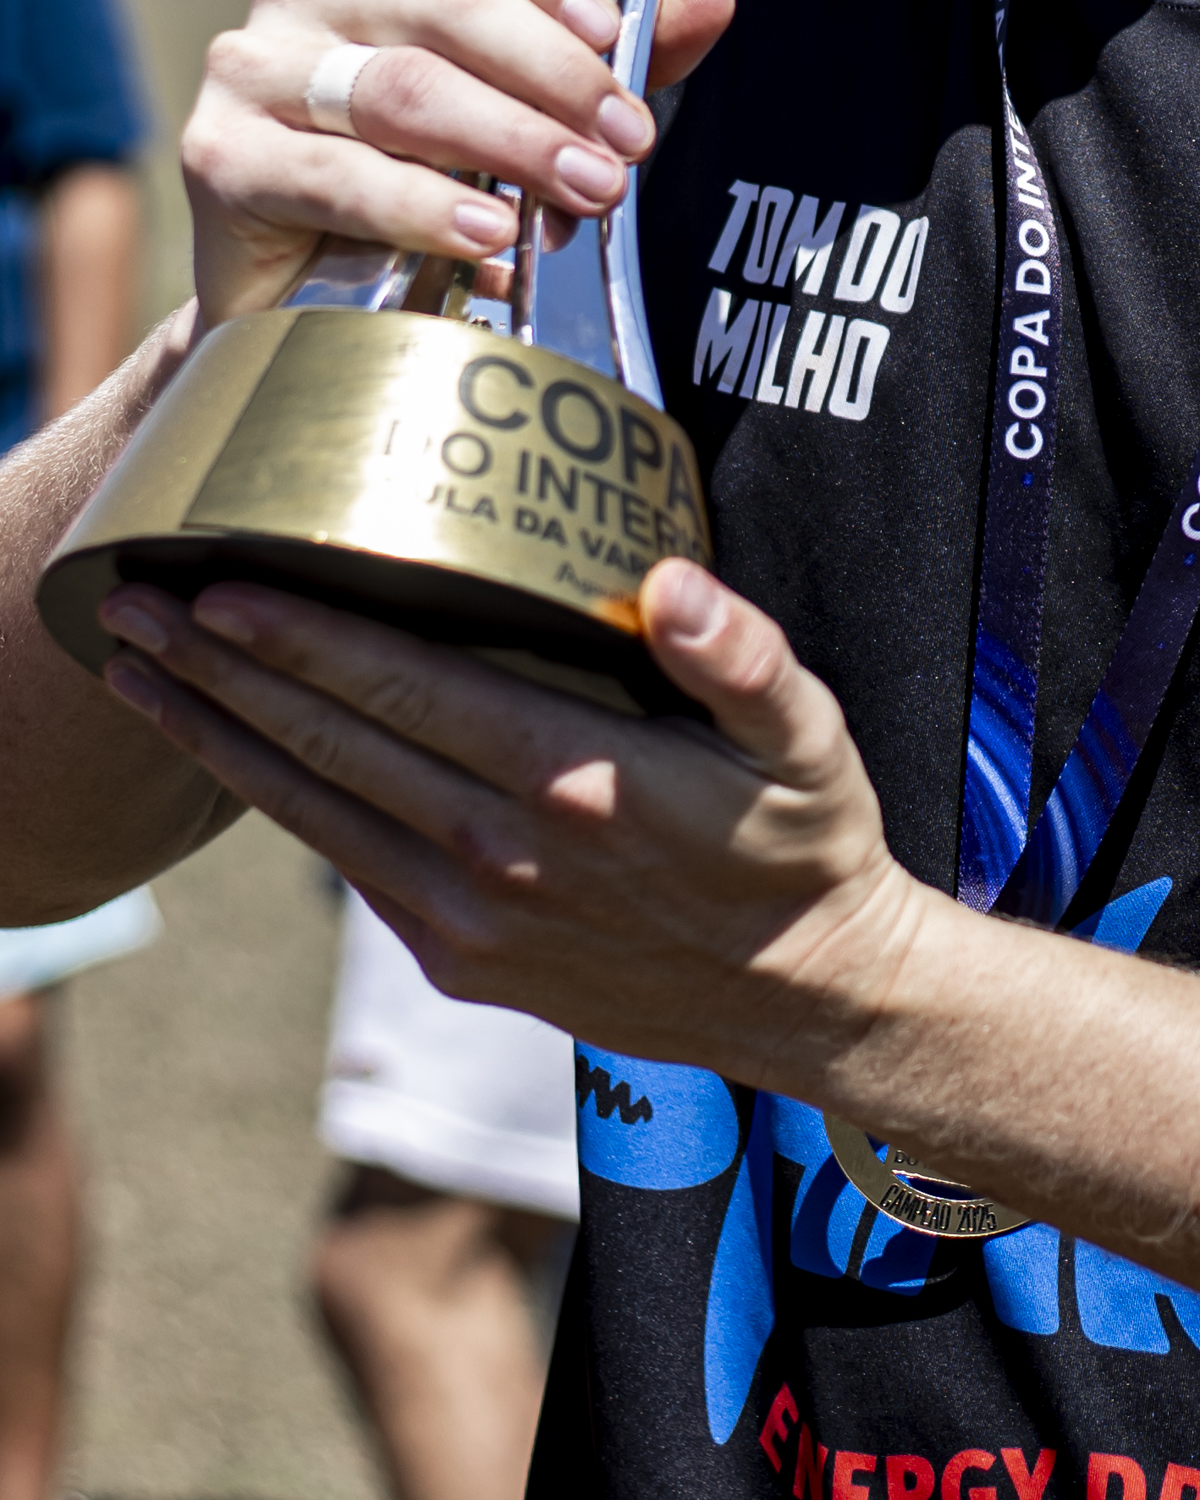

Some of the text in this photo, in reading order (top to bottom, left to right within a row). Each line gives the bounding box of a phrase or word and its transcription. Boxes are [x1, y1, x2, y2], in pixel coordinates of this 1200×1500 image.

[708, 179, 930, 315] TOM DO
[1005, 91, 1052, 460] COPA DO INTE
[693, 287, 891, 422] MILHO
[458, 355, 702, 534] COPA
[518, 449, 703, 562] INTER
[515, 507, 568, 546] DA
[956, 1202, 998, 1233] 2025
